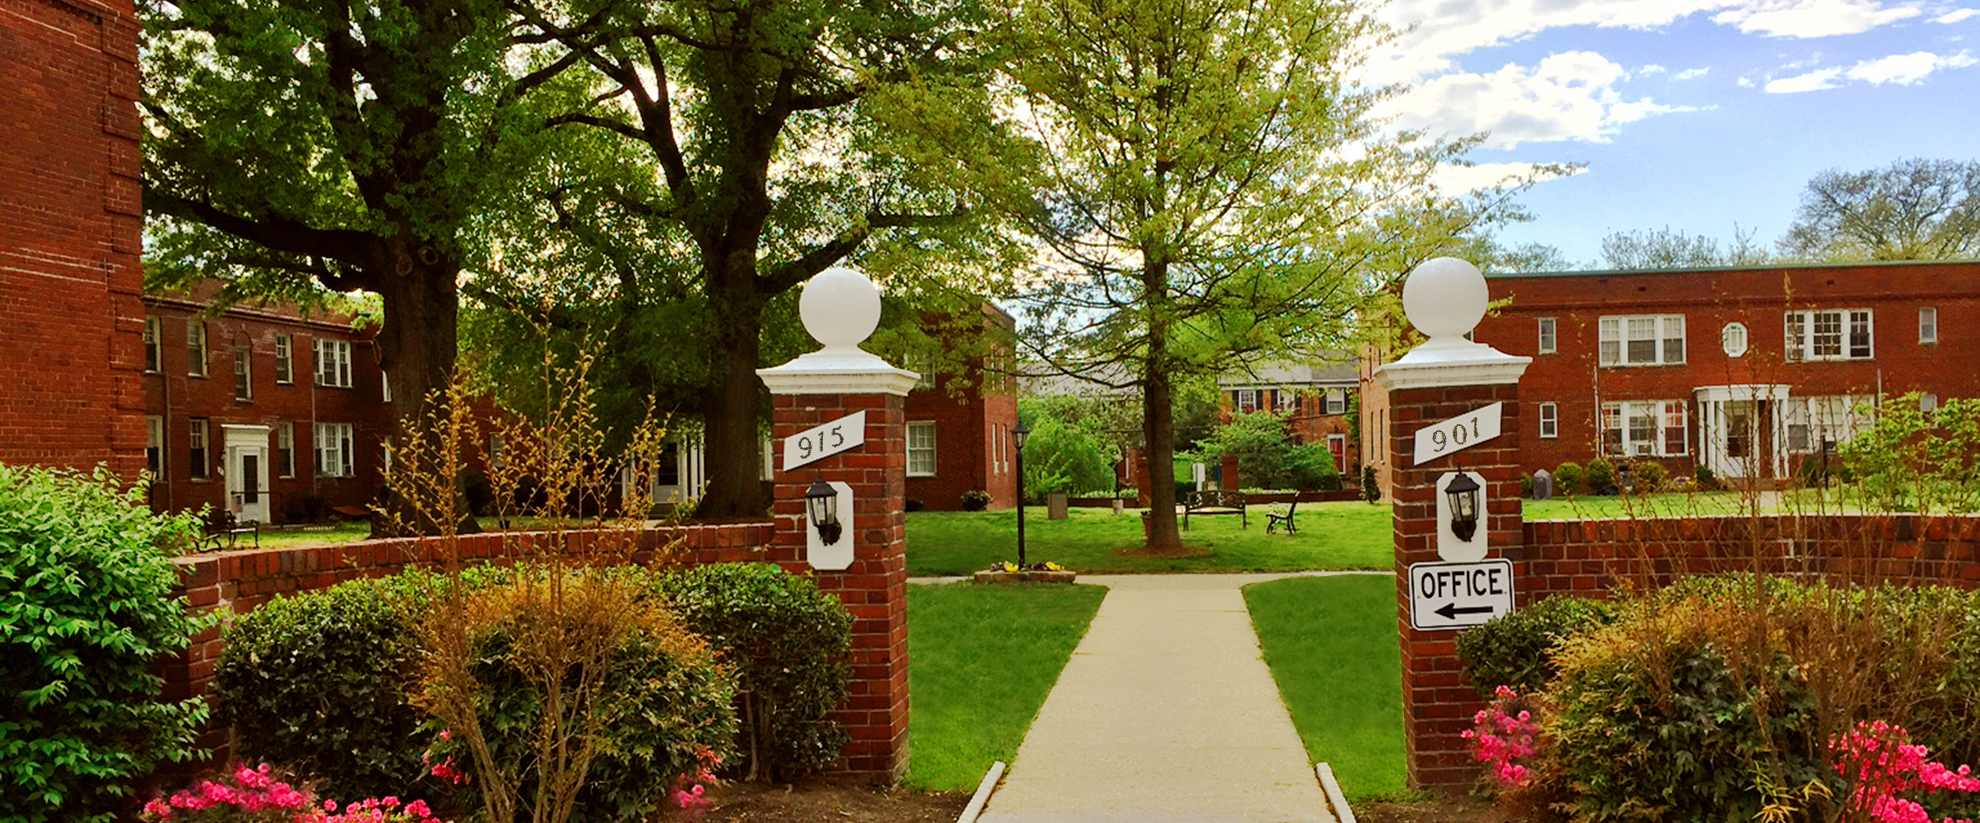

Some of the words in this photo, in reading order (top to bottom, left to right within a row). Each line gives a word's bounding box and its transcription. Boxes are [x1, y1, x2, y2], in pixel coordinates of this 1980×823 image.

[798, 424, 845, 459] 915
[1431, 416, 1479, 453] 901
[1421, 568, 1503, 599] OFFICE
